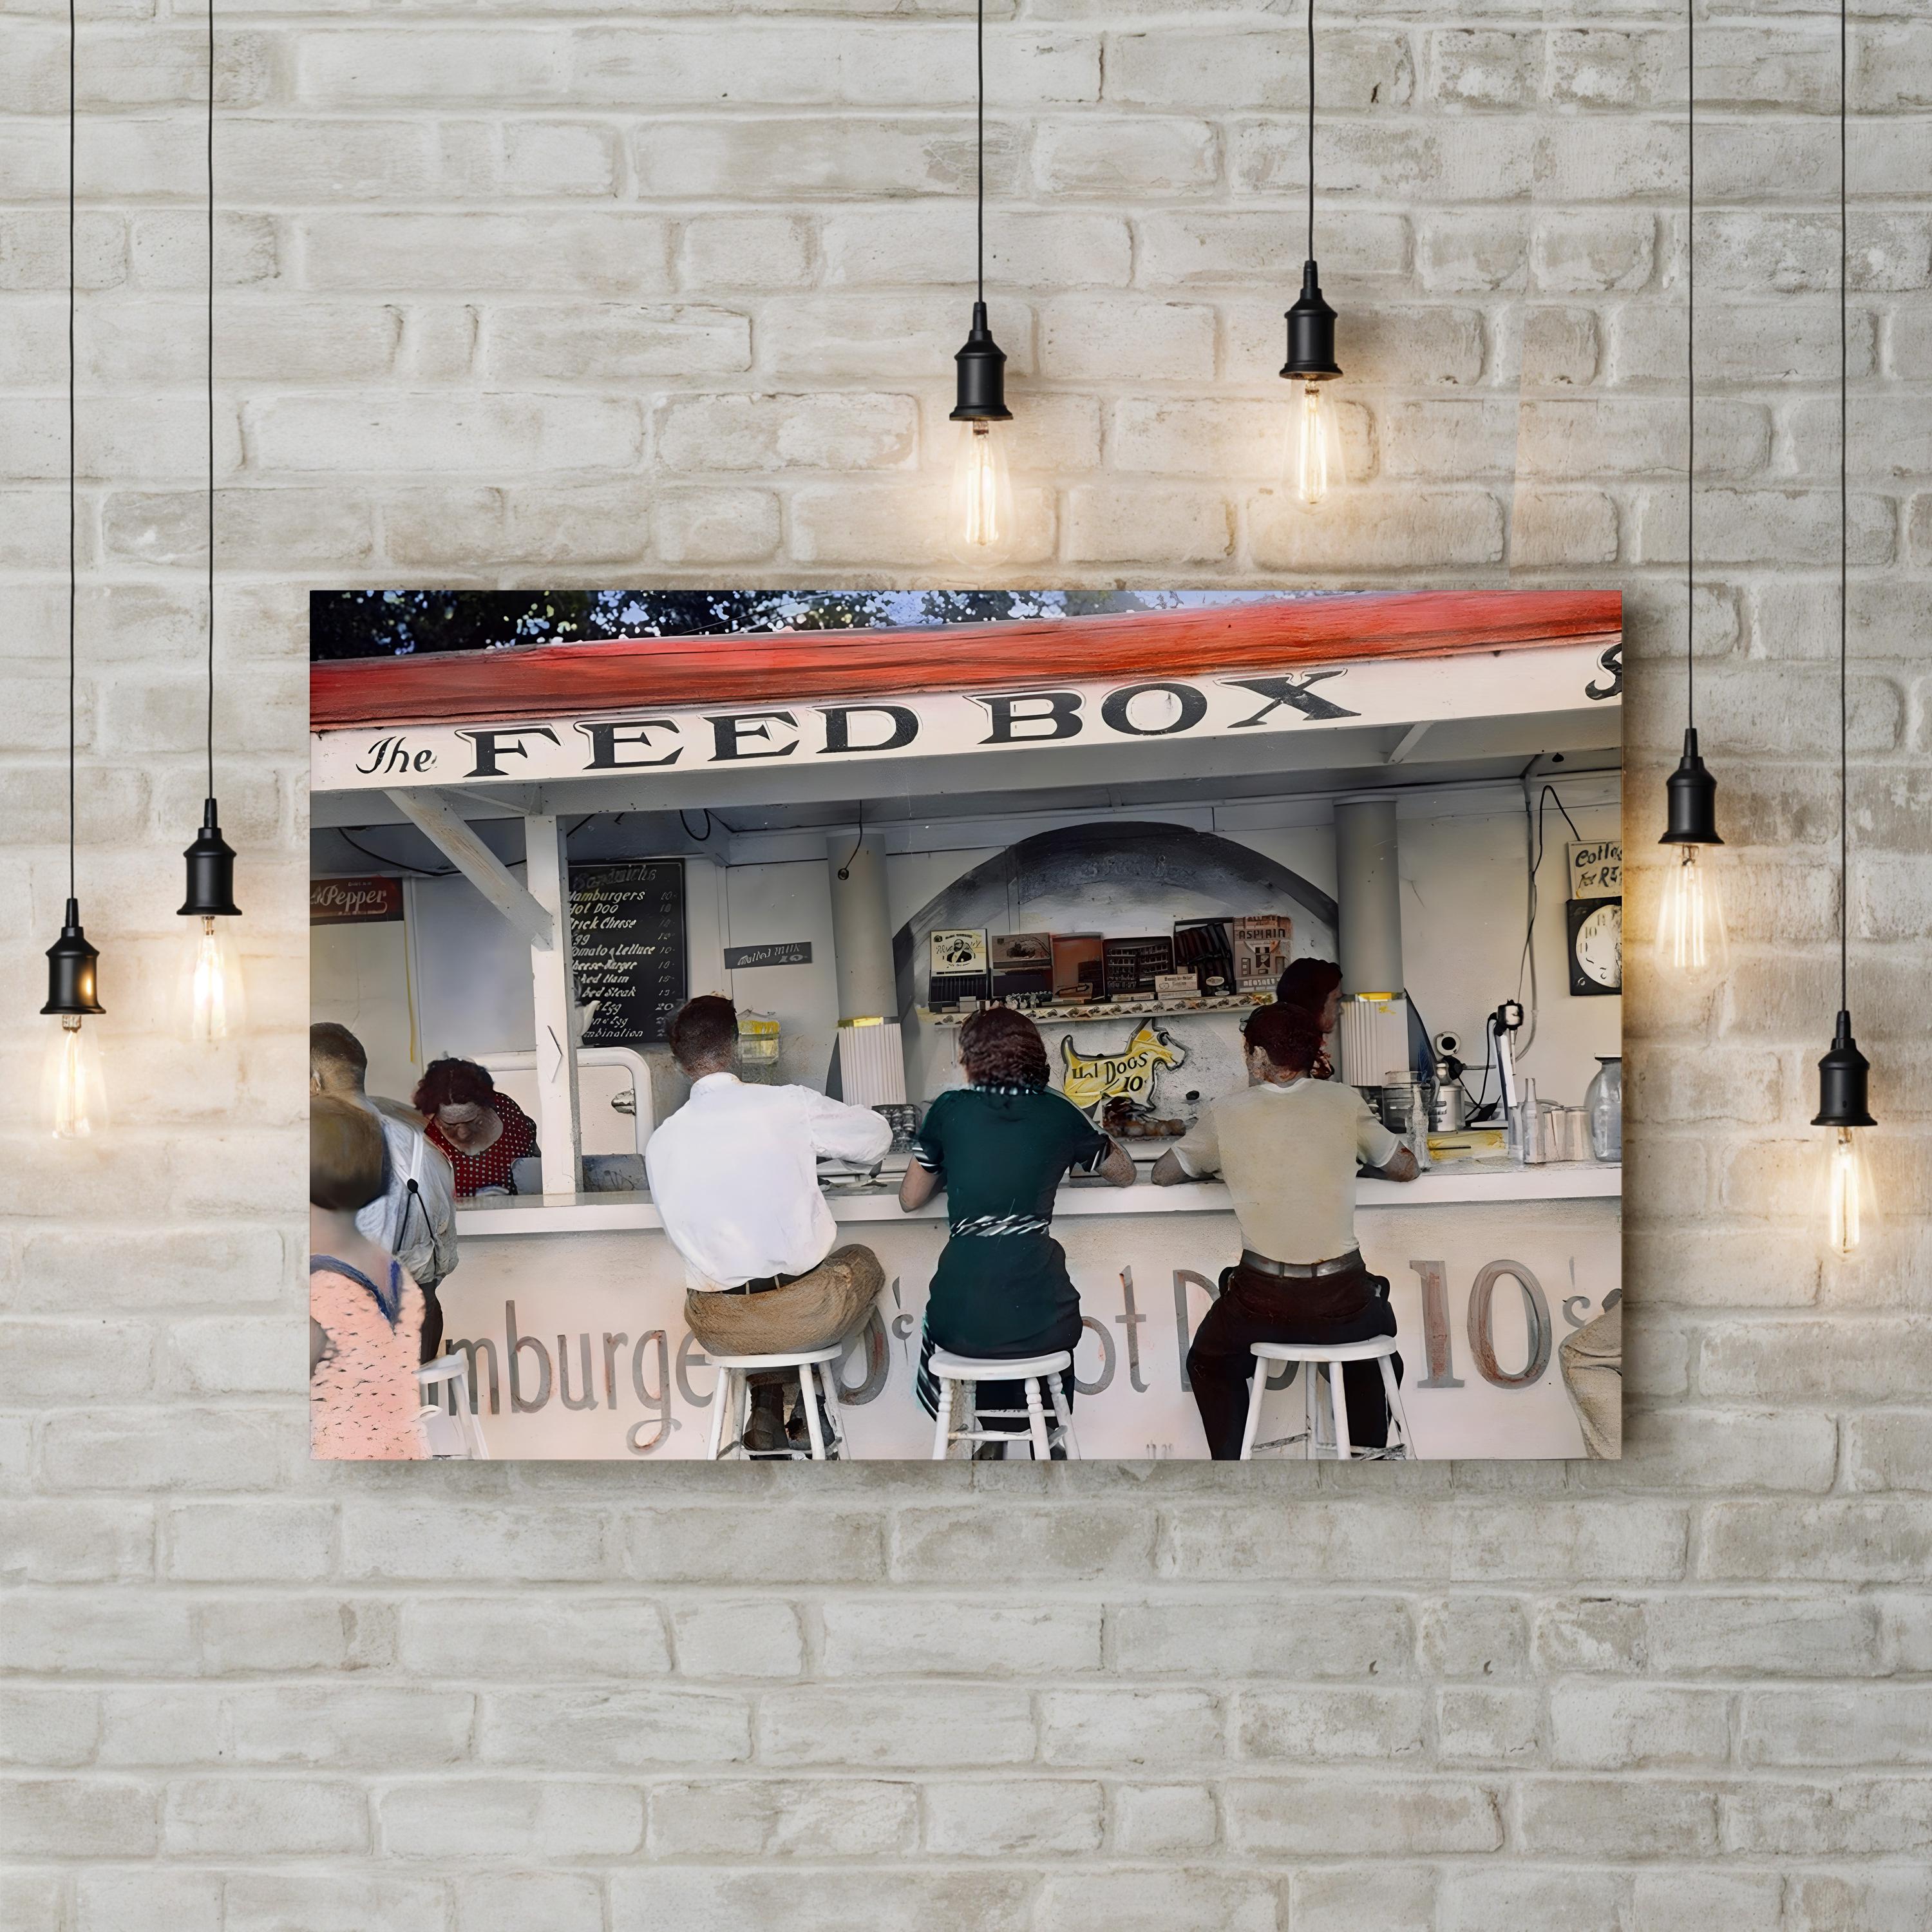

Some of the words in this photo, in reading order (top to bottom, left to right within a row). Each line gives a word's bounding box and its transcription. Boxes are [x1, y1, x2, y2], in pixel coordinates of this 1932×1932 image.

[356, 735, 437, 774] The
[455, 706, 919, 778] FEED
[965, 670, 1361, 745] BOX
[320, 884, 388, 914] Pepper
[583, 1028, 643, 1037] mbination
